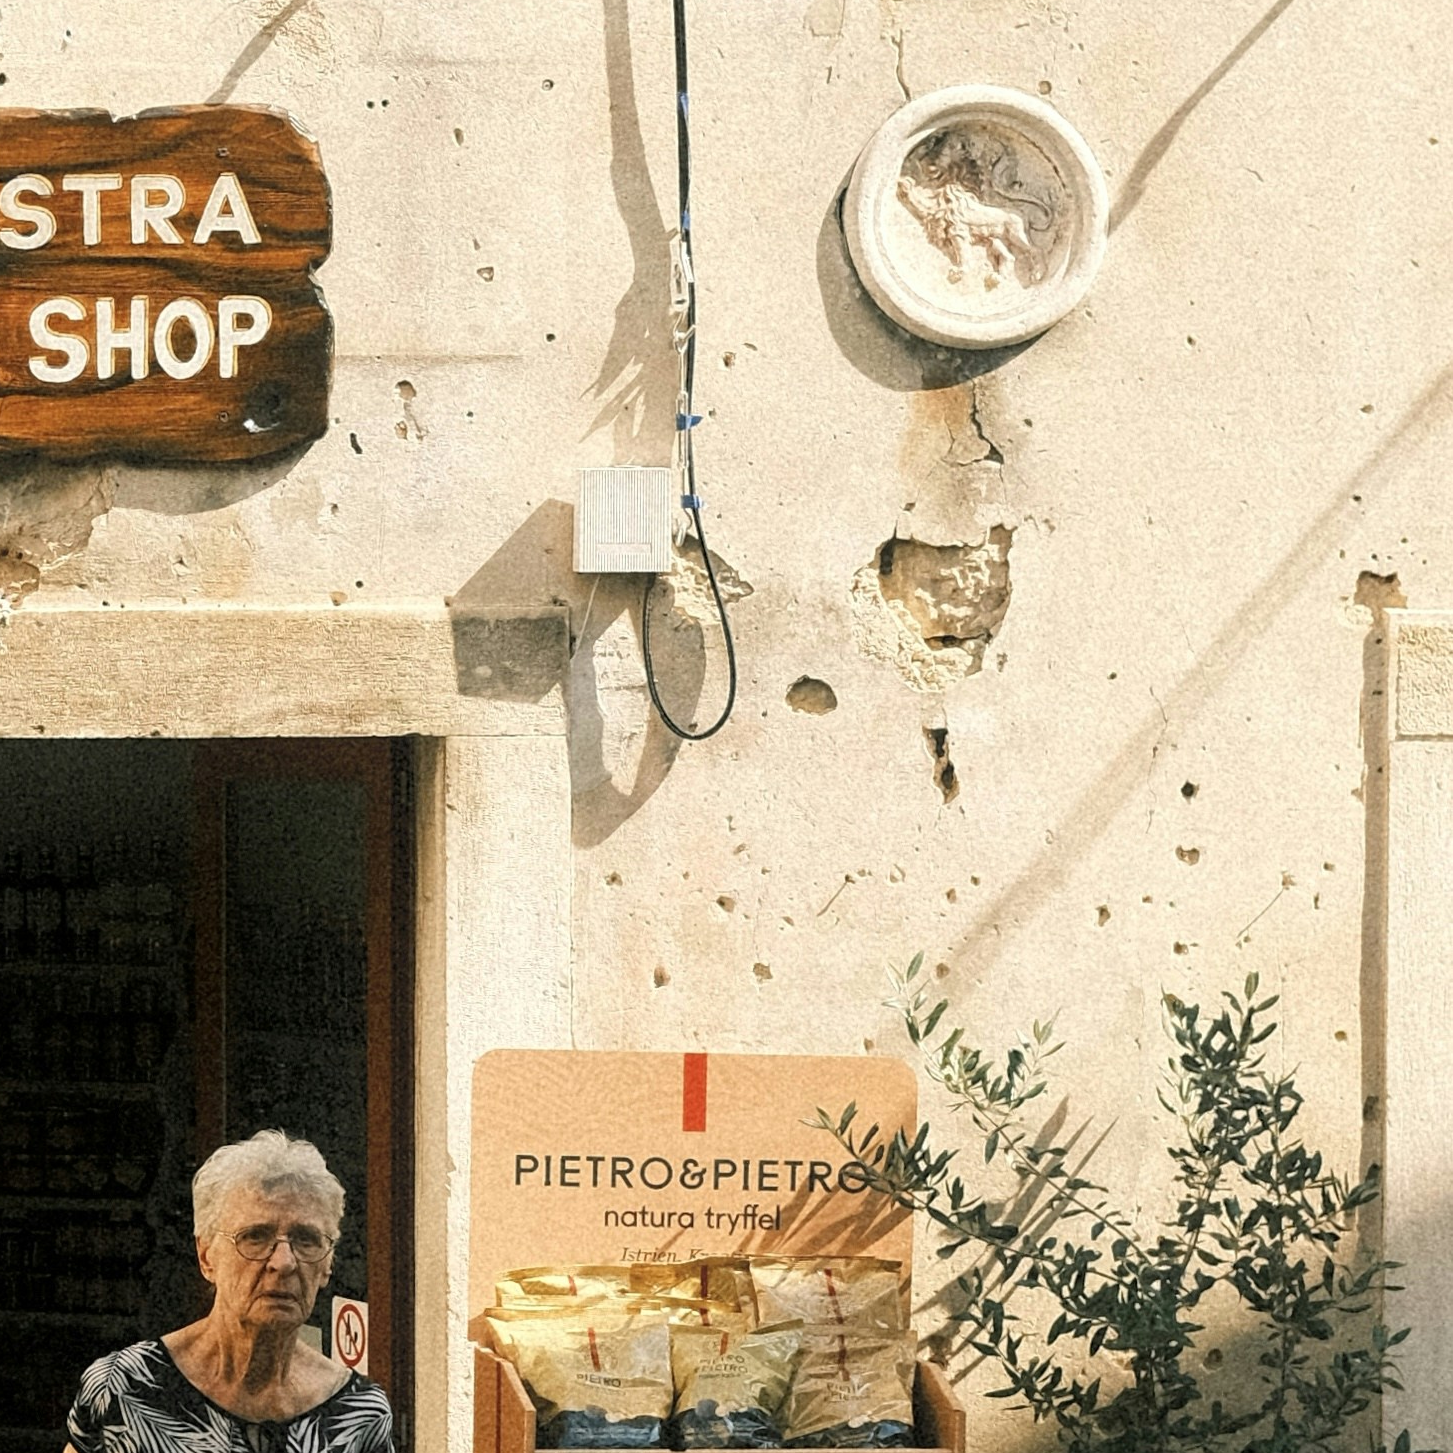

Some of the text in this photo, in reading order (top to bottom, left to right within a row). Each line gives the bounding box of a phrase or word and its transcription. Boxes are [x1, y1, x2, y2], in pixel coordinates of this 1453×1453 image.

[28, 295, 273, 384] SHOP
[514, 1154, 870, 1195] PIETRO&PIETRO
[604, 1204, 782, 1235] natura tryffel
